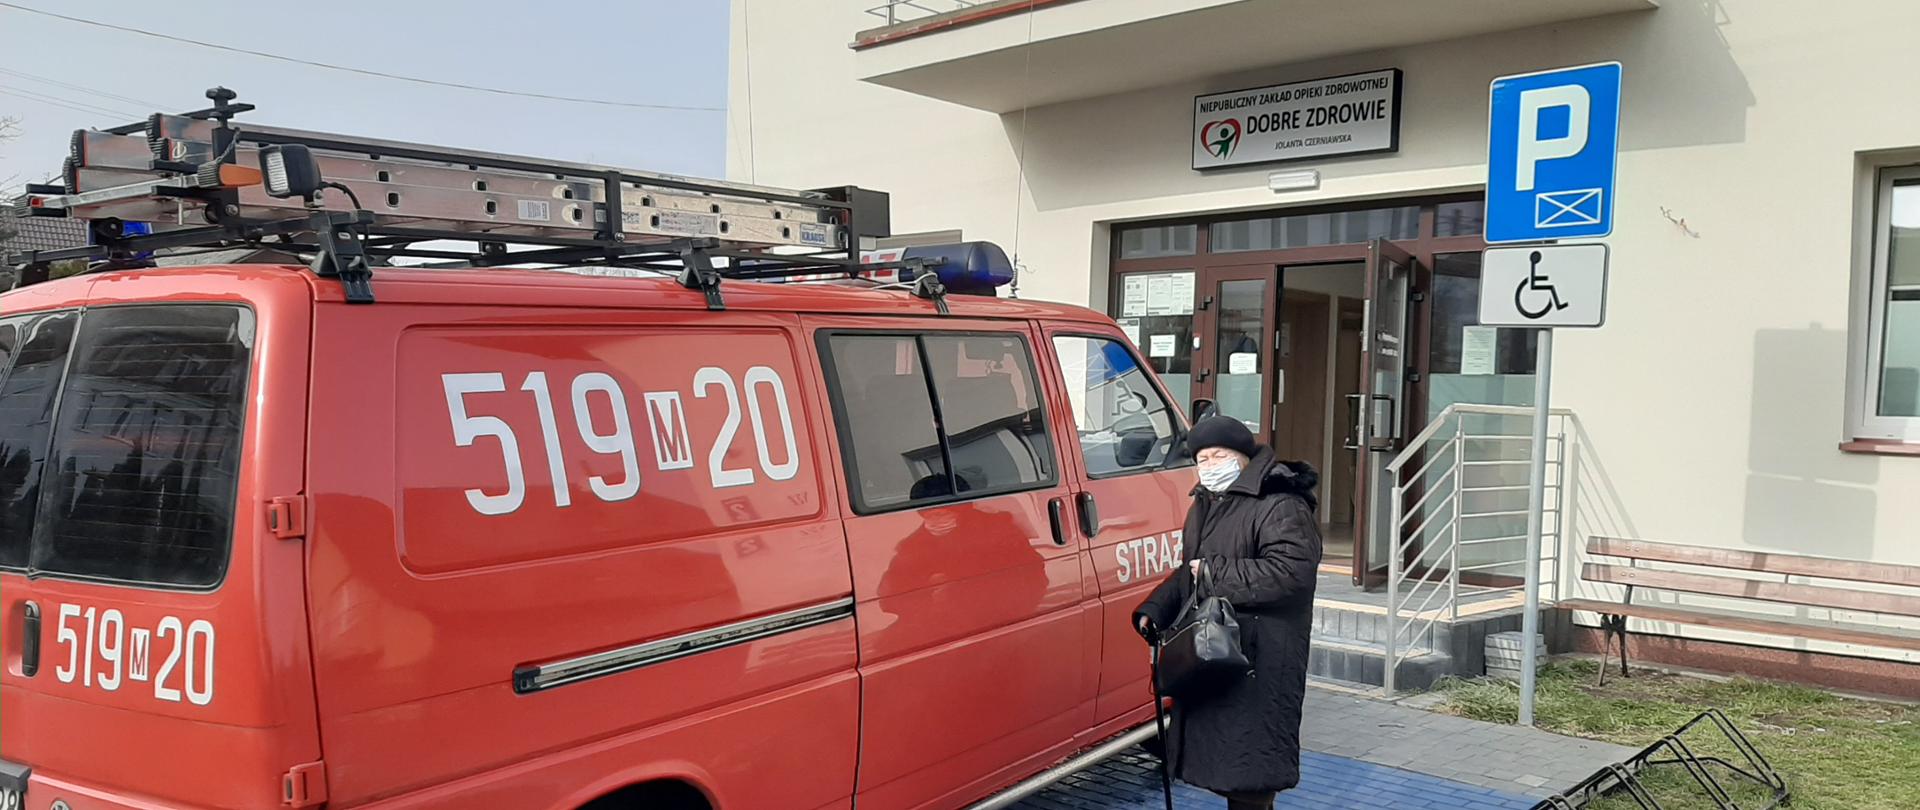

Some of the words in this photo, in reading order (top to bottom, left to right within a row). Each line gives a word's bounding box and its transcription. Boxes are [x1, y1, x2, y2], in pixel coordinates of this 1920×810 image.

[1200, 95, 1258, 113] NIEPUBLICZNY
[1259, 89, 1292, 105] ZAKŁAD
[1294, 86, 1323, 100] OPIEKI
[1325, 77, 1389, 97] ZDROWOTNEJ
[1247, 110, 1300, 135] DOBRE
[1305, 99, 1386, 128] ZDROWIE
[1275, 139, 1303, 150] JOLANTA
[1304, 134, 1352, 147] CZERNIAWSKA
[1516, 84, 1590, 191] P
